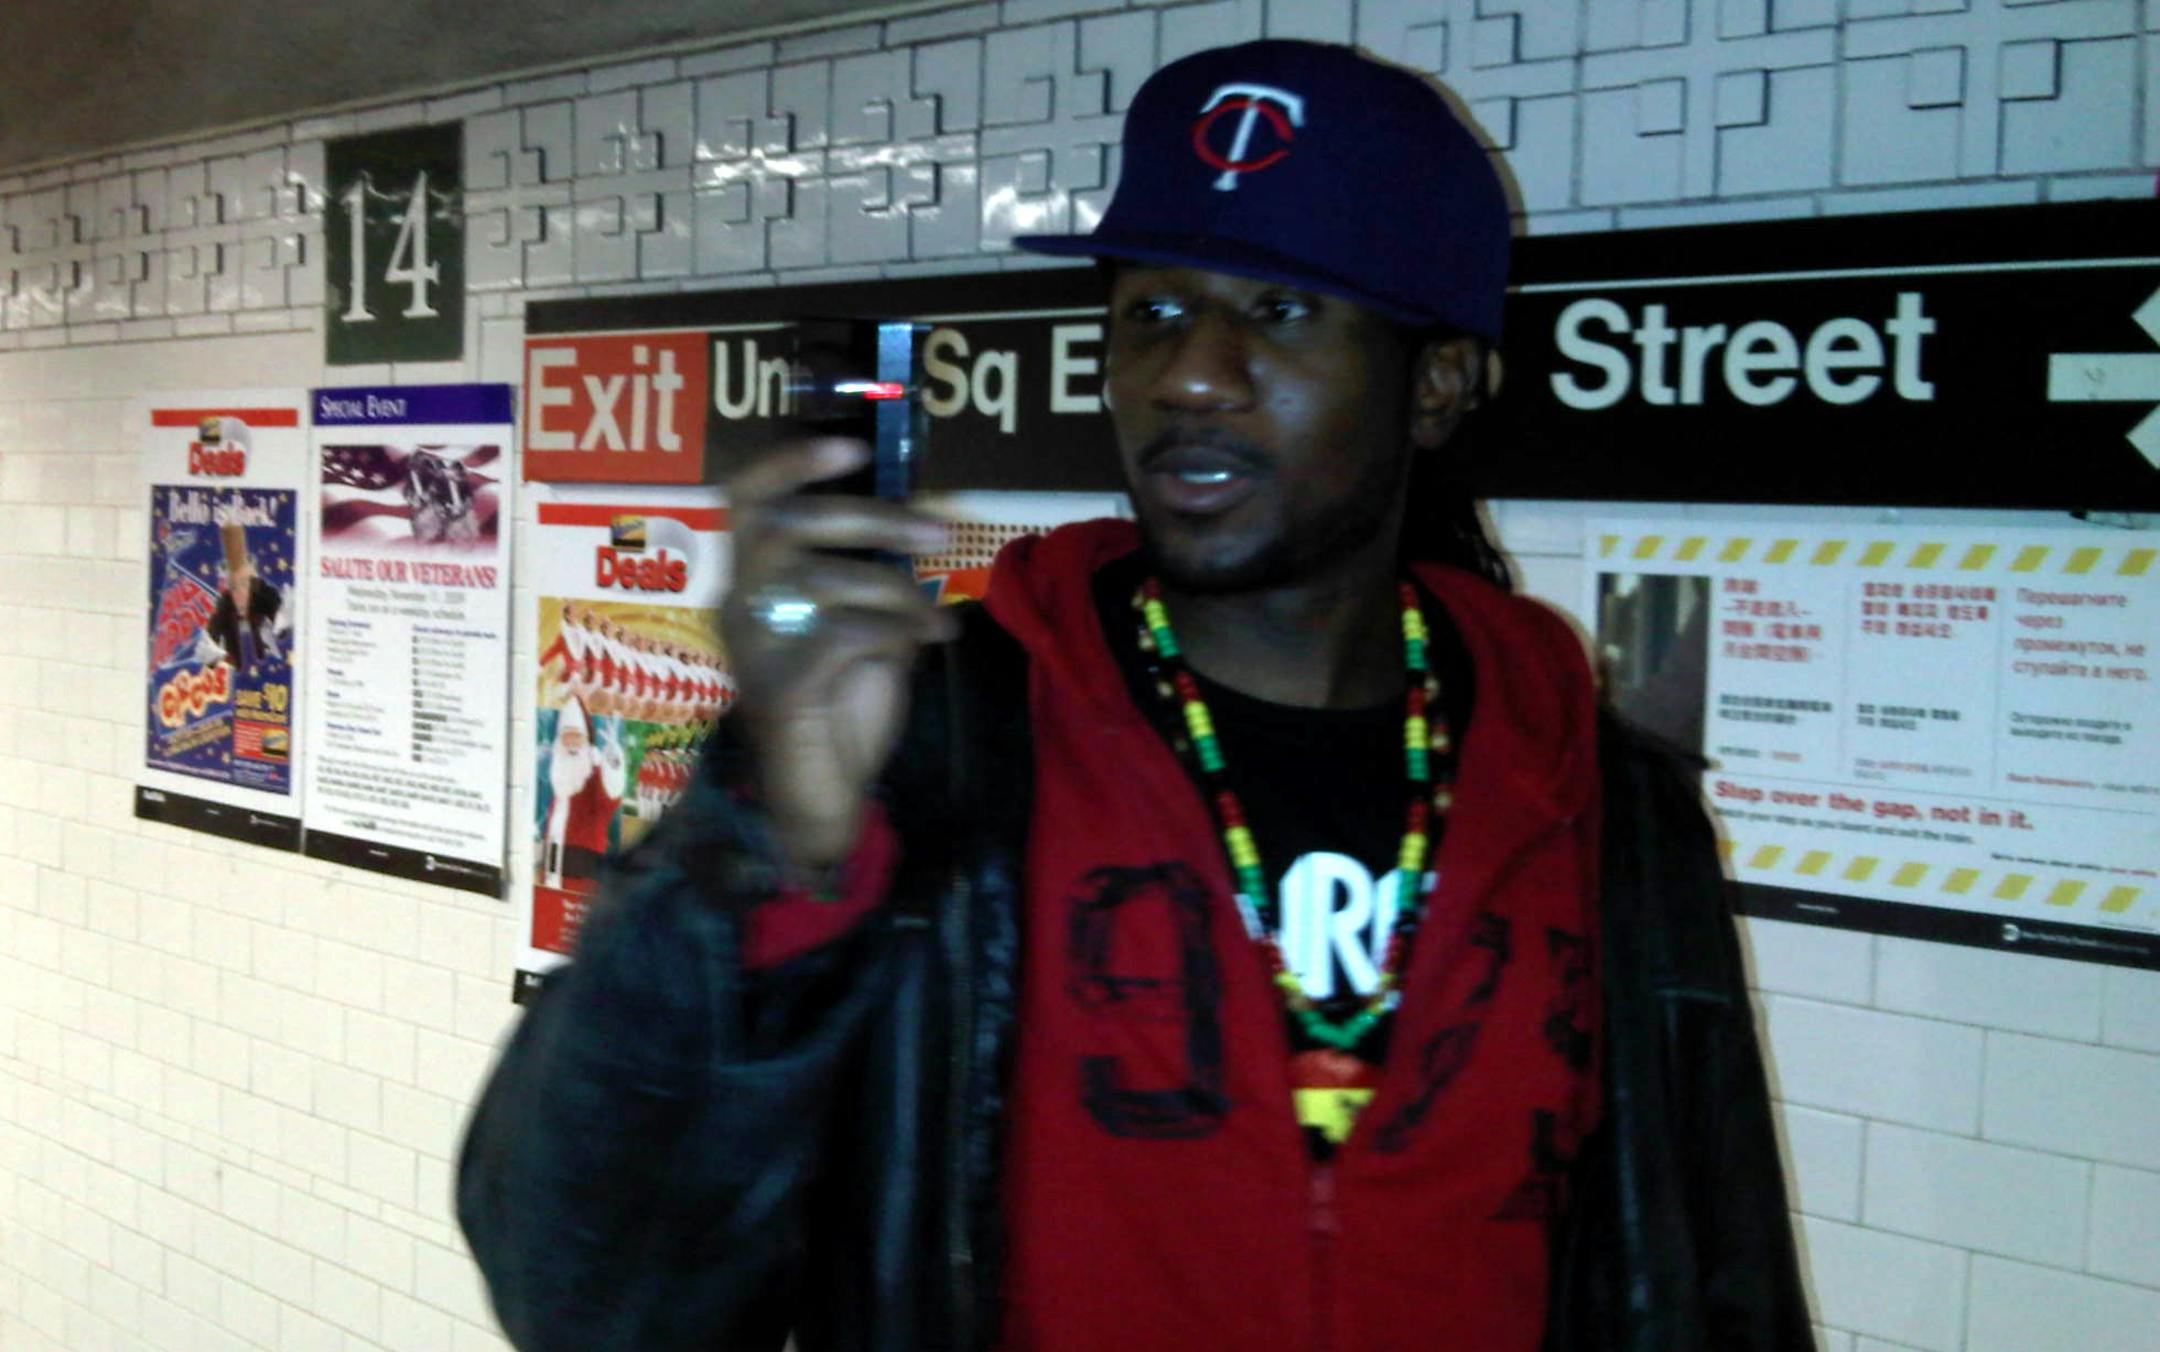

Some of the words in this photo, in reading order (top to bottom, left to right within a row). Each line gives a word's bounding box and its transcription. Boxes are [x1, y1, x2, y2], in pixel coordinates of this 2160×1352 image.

[340, 170, 440, 321] 14
[528, 344, 684, 452] Exit
[922, 327, 1018, 434] Sq
[1549, 292, 1937, 411] Street
[320, 555, 374, 581] SALUTE
[377, 559, 408, 584] OUR
[596, 545, 688, 592] Deals
[1715, 780, 1763, 804] Step
[1771, 789, 1820, 807] over
[1828, 793, 1866, 812] the
[1873, 801, 1923, 821] gap,
[1930, 805, 1971, 823] not
[1978, 806, 2002, 826] in
[2007, 810, 2034, 830] it.
